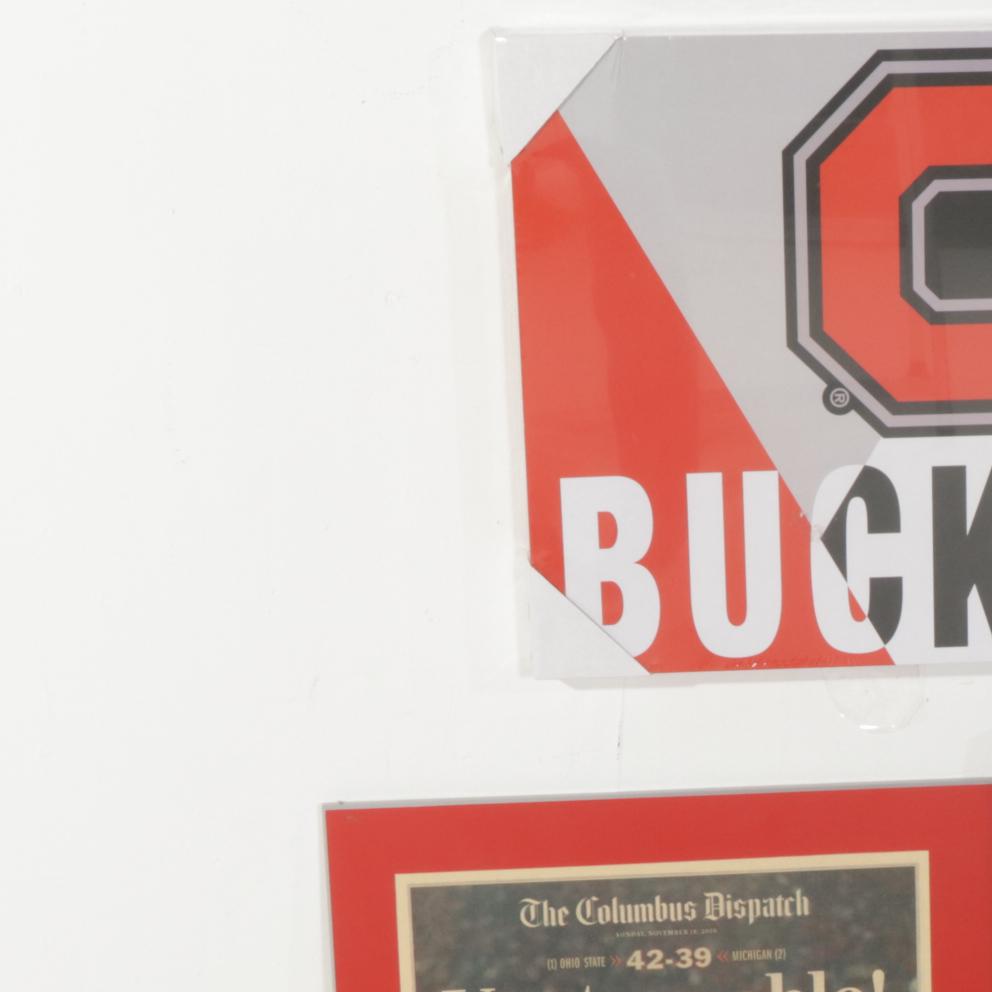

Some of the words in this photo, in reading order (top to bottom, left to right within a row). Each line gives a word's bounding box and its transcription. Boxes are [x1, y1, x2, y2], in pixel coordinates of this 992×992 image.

[519, 898, 569, 927] The
[575, 895, 697, 925] Columbus
[703, 889, 811, 924] Dispatch
[560, 957, 581, 970] OHIO
[583, 956, 606, 969] STATE
[626, 948, 712, 971] 42-39
[732, 949, 772, 961] MICHIGAN
